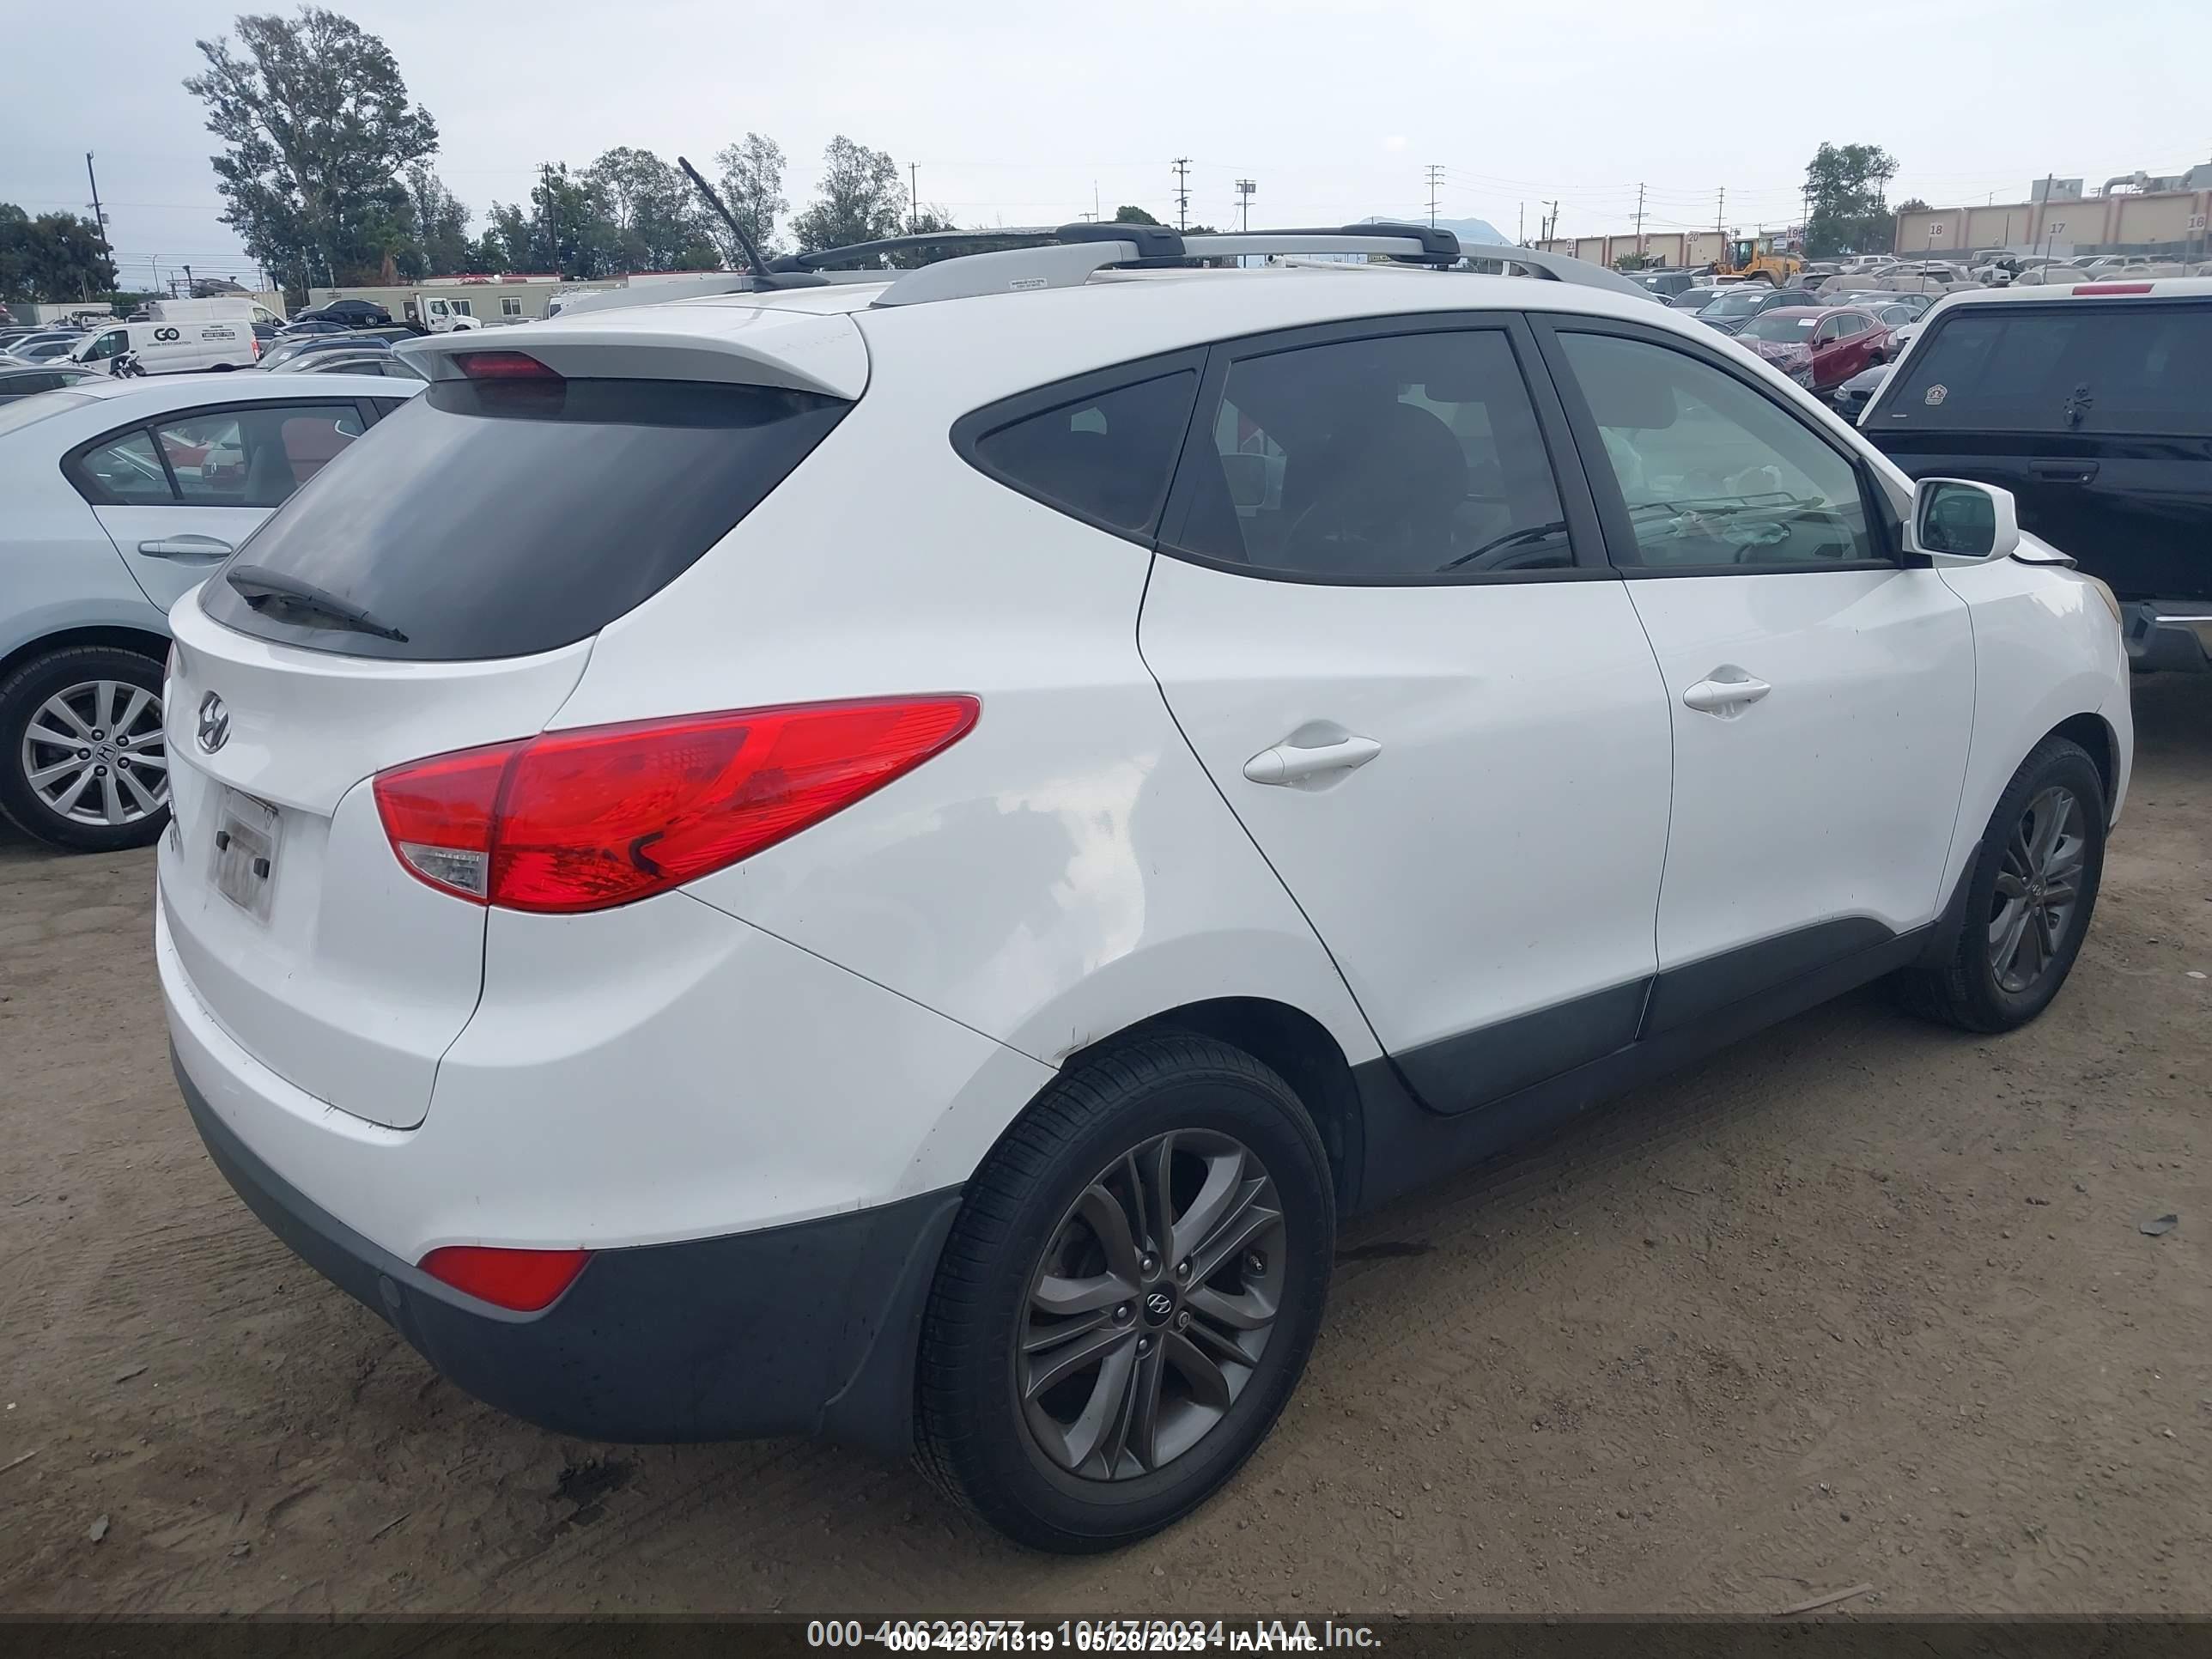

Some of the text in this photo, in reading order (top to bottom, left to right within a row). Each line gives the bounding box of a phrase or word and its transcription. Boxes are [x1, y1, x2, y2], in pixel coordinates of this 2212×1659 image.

[1929, 225, 1943, 234] 18
[2050, 222, 2065, 234] 17
[1688, 233, 1698, 242] 20
[1787, 228, 1799, 238] 19
[1566, 241, 1575, 250] 21
[154, 327, 180, 342] GO
